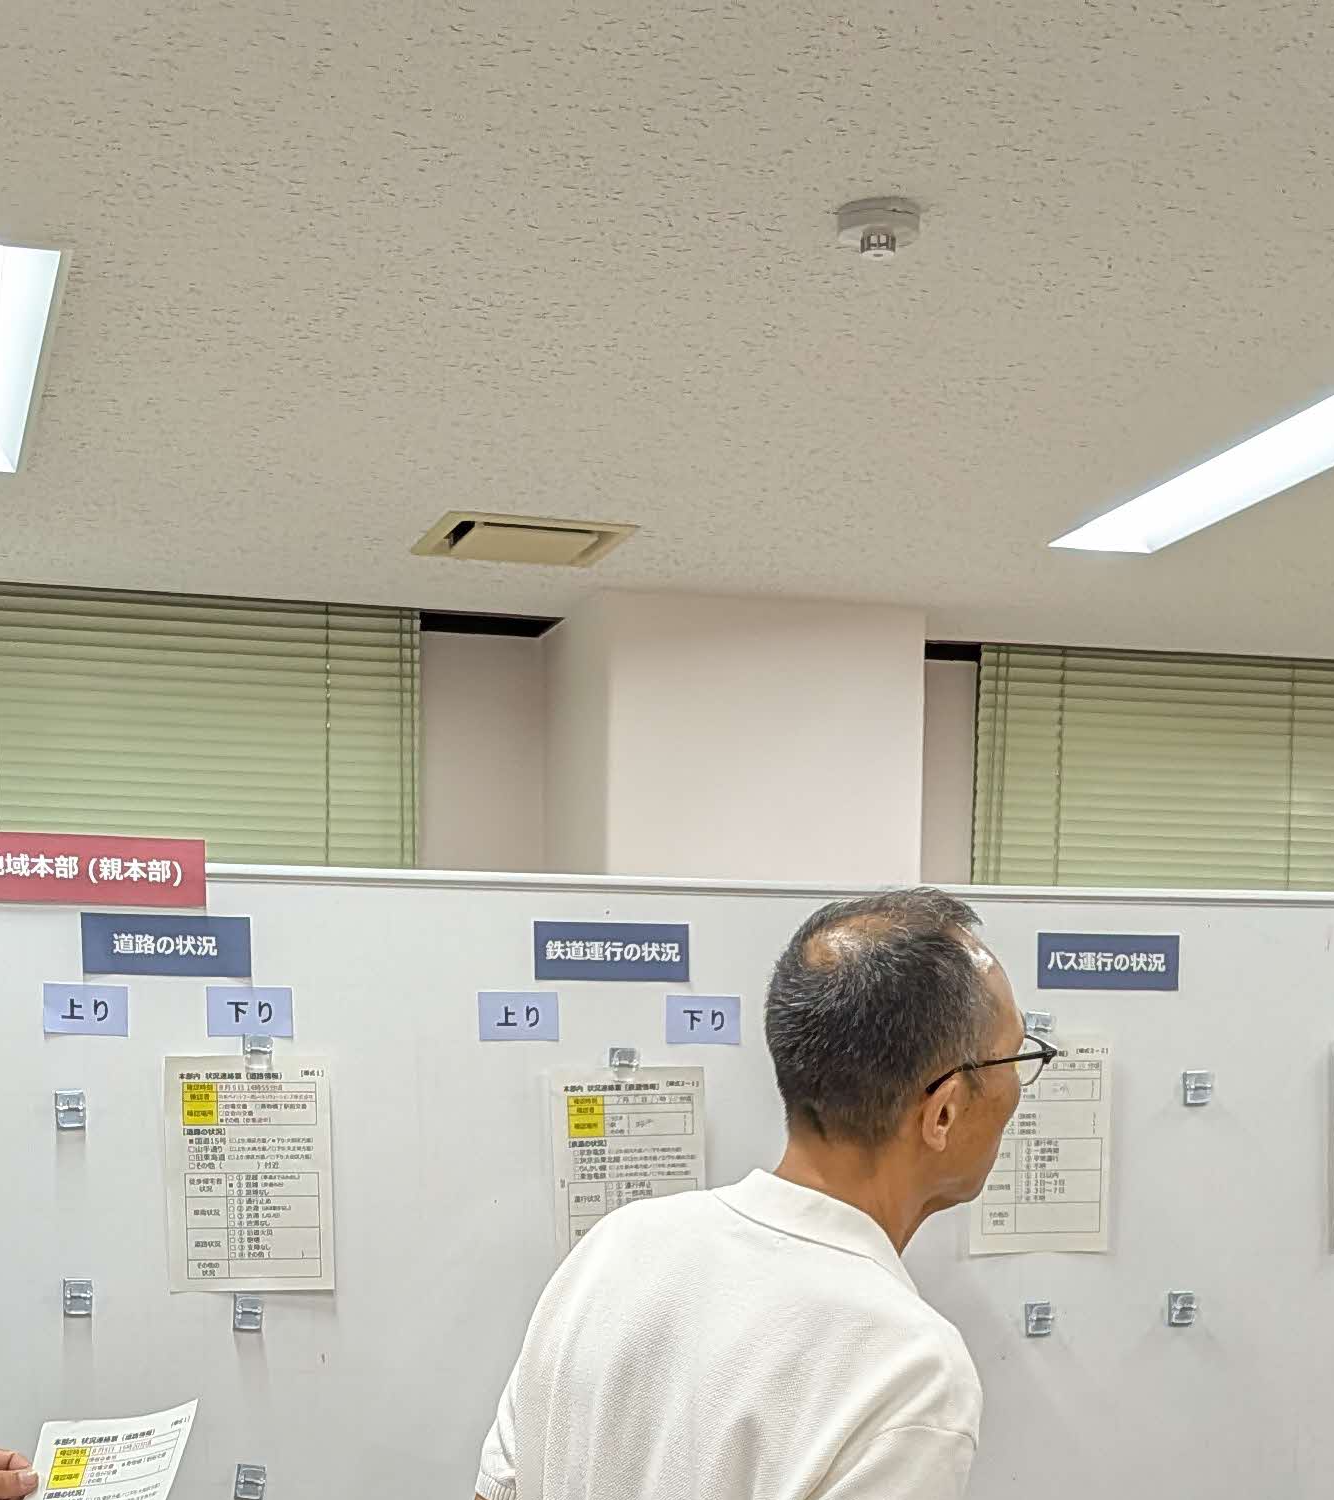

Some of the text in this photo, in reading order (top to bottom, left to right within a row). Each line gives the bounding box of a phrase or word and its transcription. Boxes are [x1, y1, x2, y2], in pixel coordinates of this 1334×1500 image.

[112, 933, 218, 957] 道路の状況
[545, 940, 681, 963] 鉄道運行の状況
[1047, 951, 1166, 974] バス運行の状況
[61, 997, 110, 1023] 上り
[227, 1000, 274, 1024] 下り
[496, 1005, 540, 1028] 上り
[683, 1009, 725, 1031] 下り
